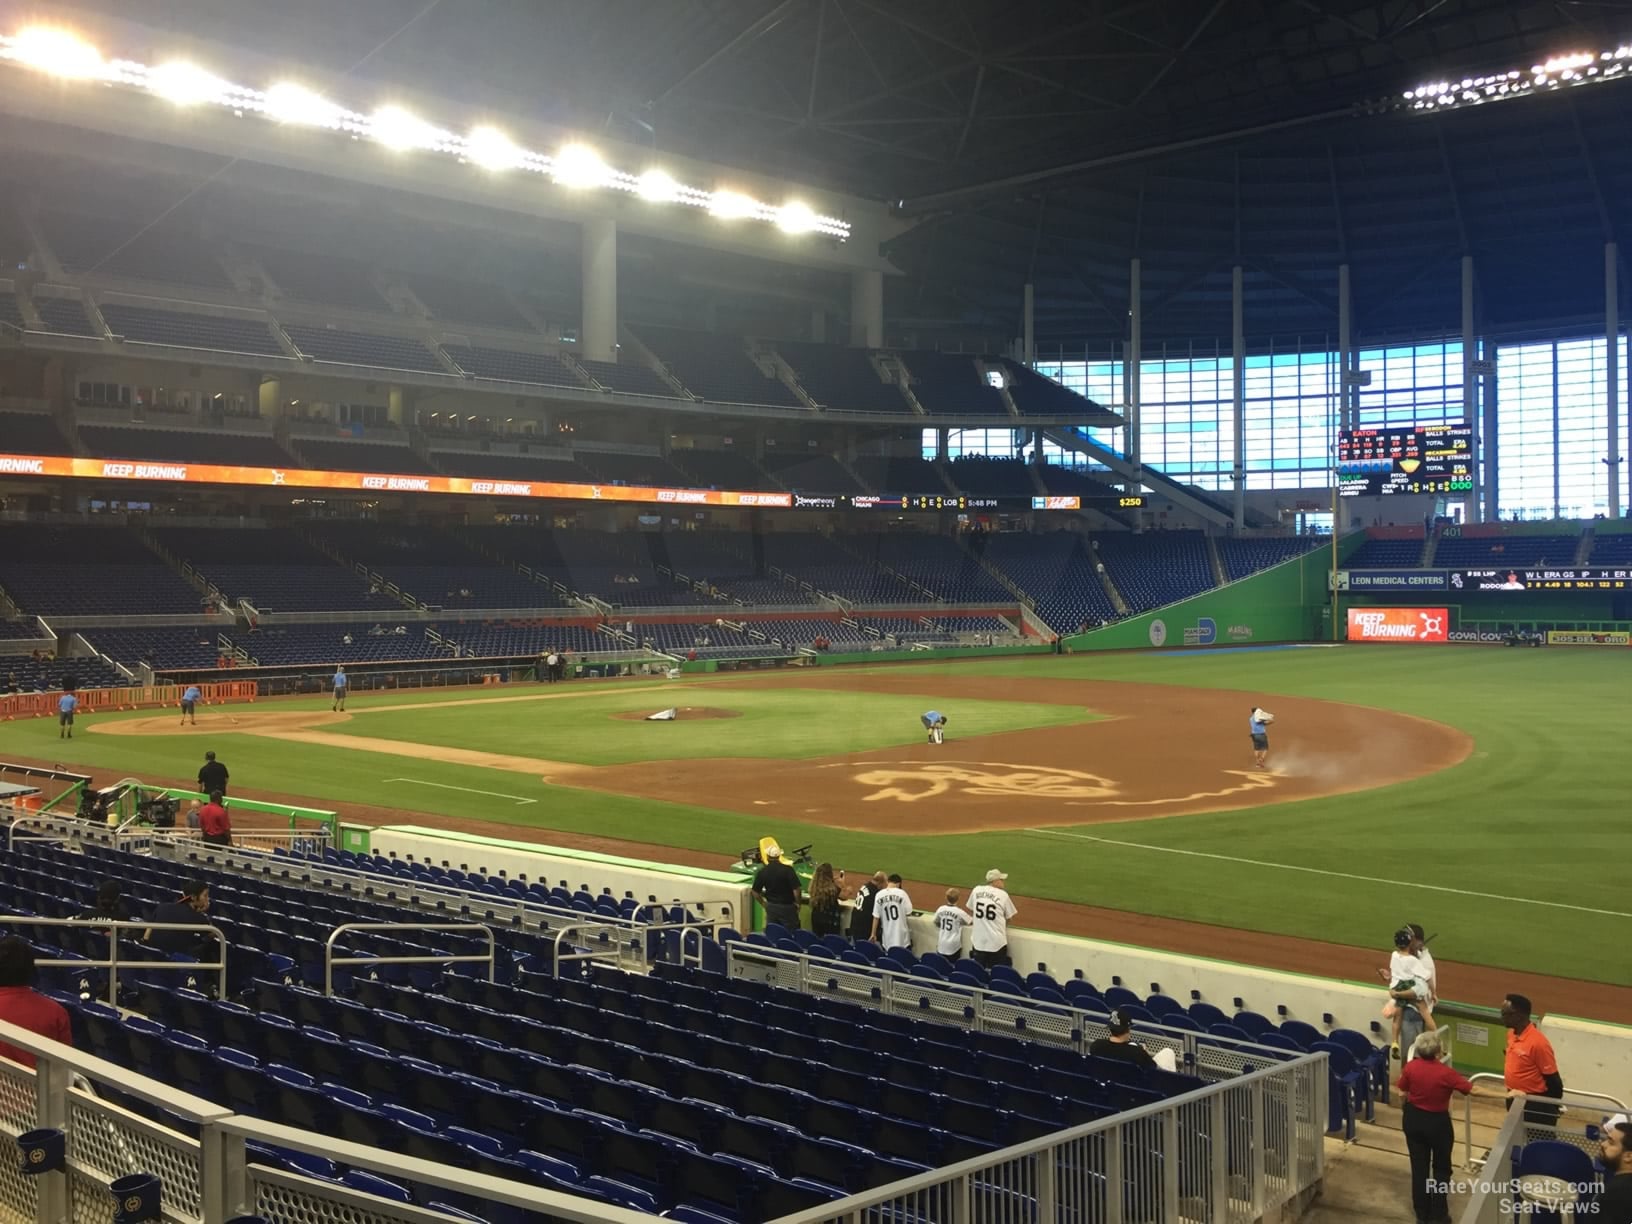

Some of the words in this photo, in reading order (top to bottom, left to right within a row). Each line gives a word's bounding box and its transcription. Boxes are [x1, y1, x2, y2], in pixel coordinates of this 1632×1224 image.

[0, 458, 43, 473] RNING
[104, 463, 133, 477] KEEP
[135, 465, 187, 480] BURNING
[363, 476, 387, 488] KEEP
[388, 478, 429, 490] BURNING
[472, 482, 494, 493] KEEP
[495, 483, 532, 495] BURNING
[657, 491, 675, 501] KEEP
[676, 492, 706, 503] BURNING
[740, 495, 757, 505] KEEP
[1120, 498, 1141, 507] $250
[1443, 528, 1461, 536] 401
[1351, 577, 1371, 585] LEON
[1373, 577, 1406, 585] MEDICAL
[1408, 576, 1444, 584] CENTERS
[1355, 612, 1385, 625] KEEP
[1362, 624, 1416, 637] BURNING
[1448, 631, 1477, 640] GOYA
[884, 905, 899, 921] 10
[976, 902, 996, 921] 56
[942, 918, 953, 931] 15
[739, 967, 744, 975] 7
[765, 973, 771, 982] 6
